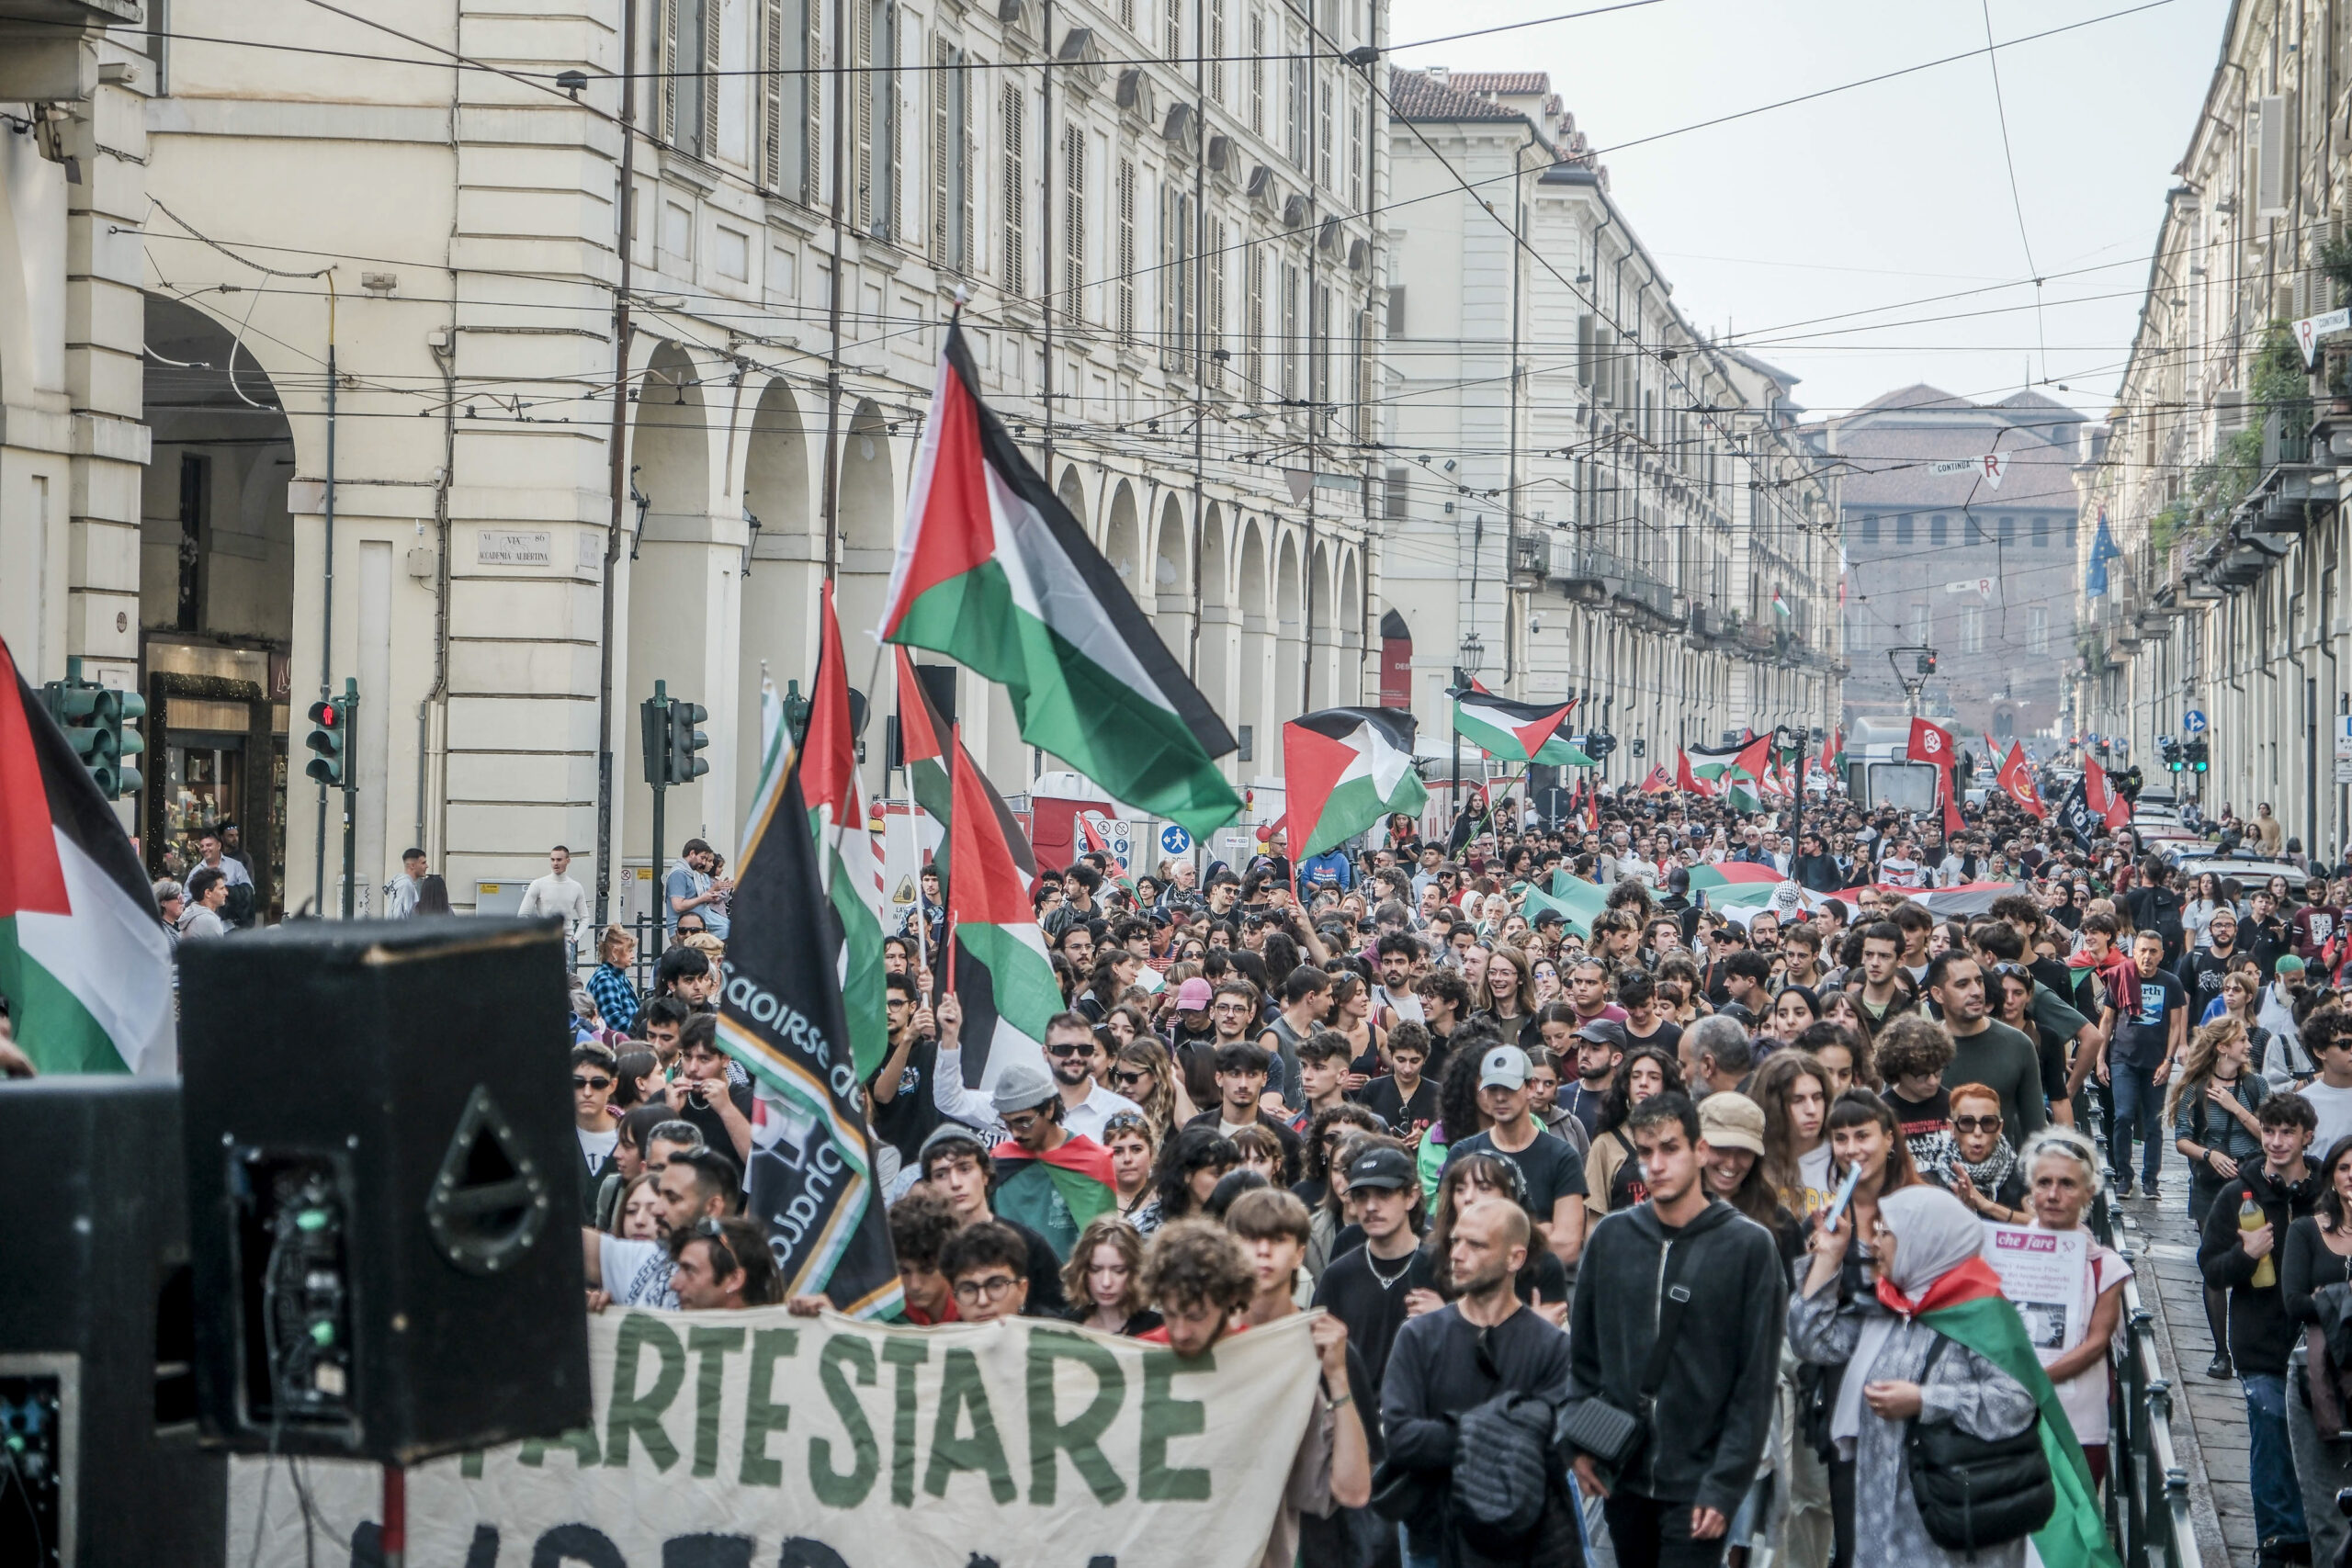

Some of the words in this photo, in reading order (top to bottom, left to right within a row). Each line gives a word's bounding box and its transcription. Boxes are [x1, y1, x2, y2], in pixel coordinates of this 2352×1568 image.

[2301, 321, 2313, 350] R
[1938, 460, 1971, 472] CONTINUA
[1984, 456, 2000, 478] R
[480, 551, 512, 559] ACCADEMIA
[515, 552, 548, 560] ALBERTINA
[1979, 579, 1991, 593] R
[1997, 1233, 2021, 1247] che
[2023, 1235, 2054, 1249] fare
